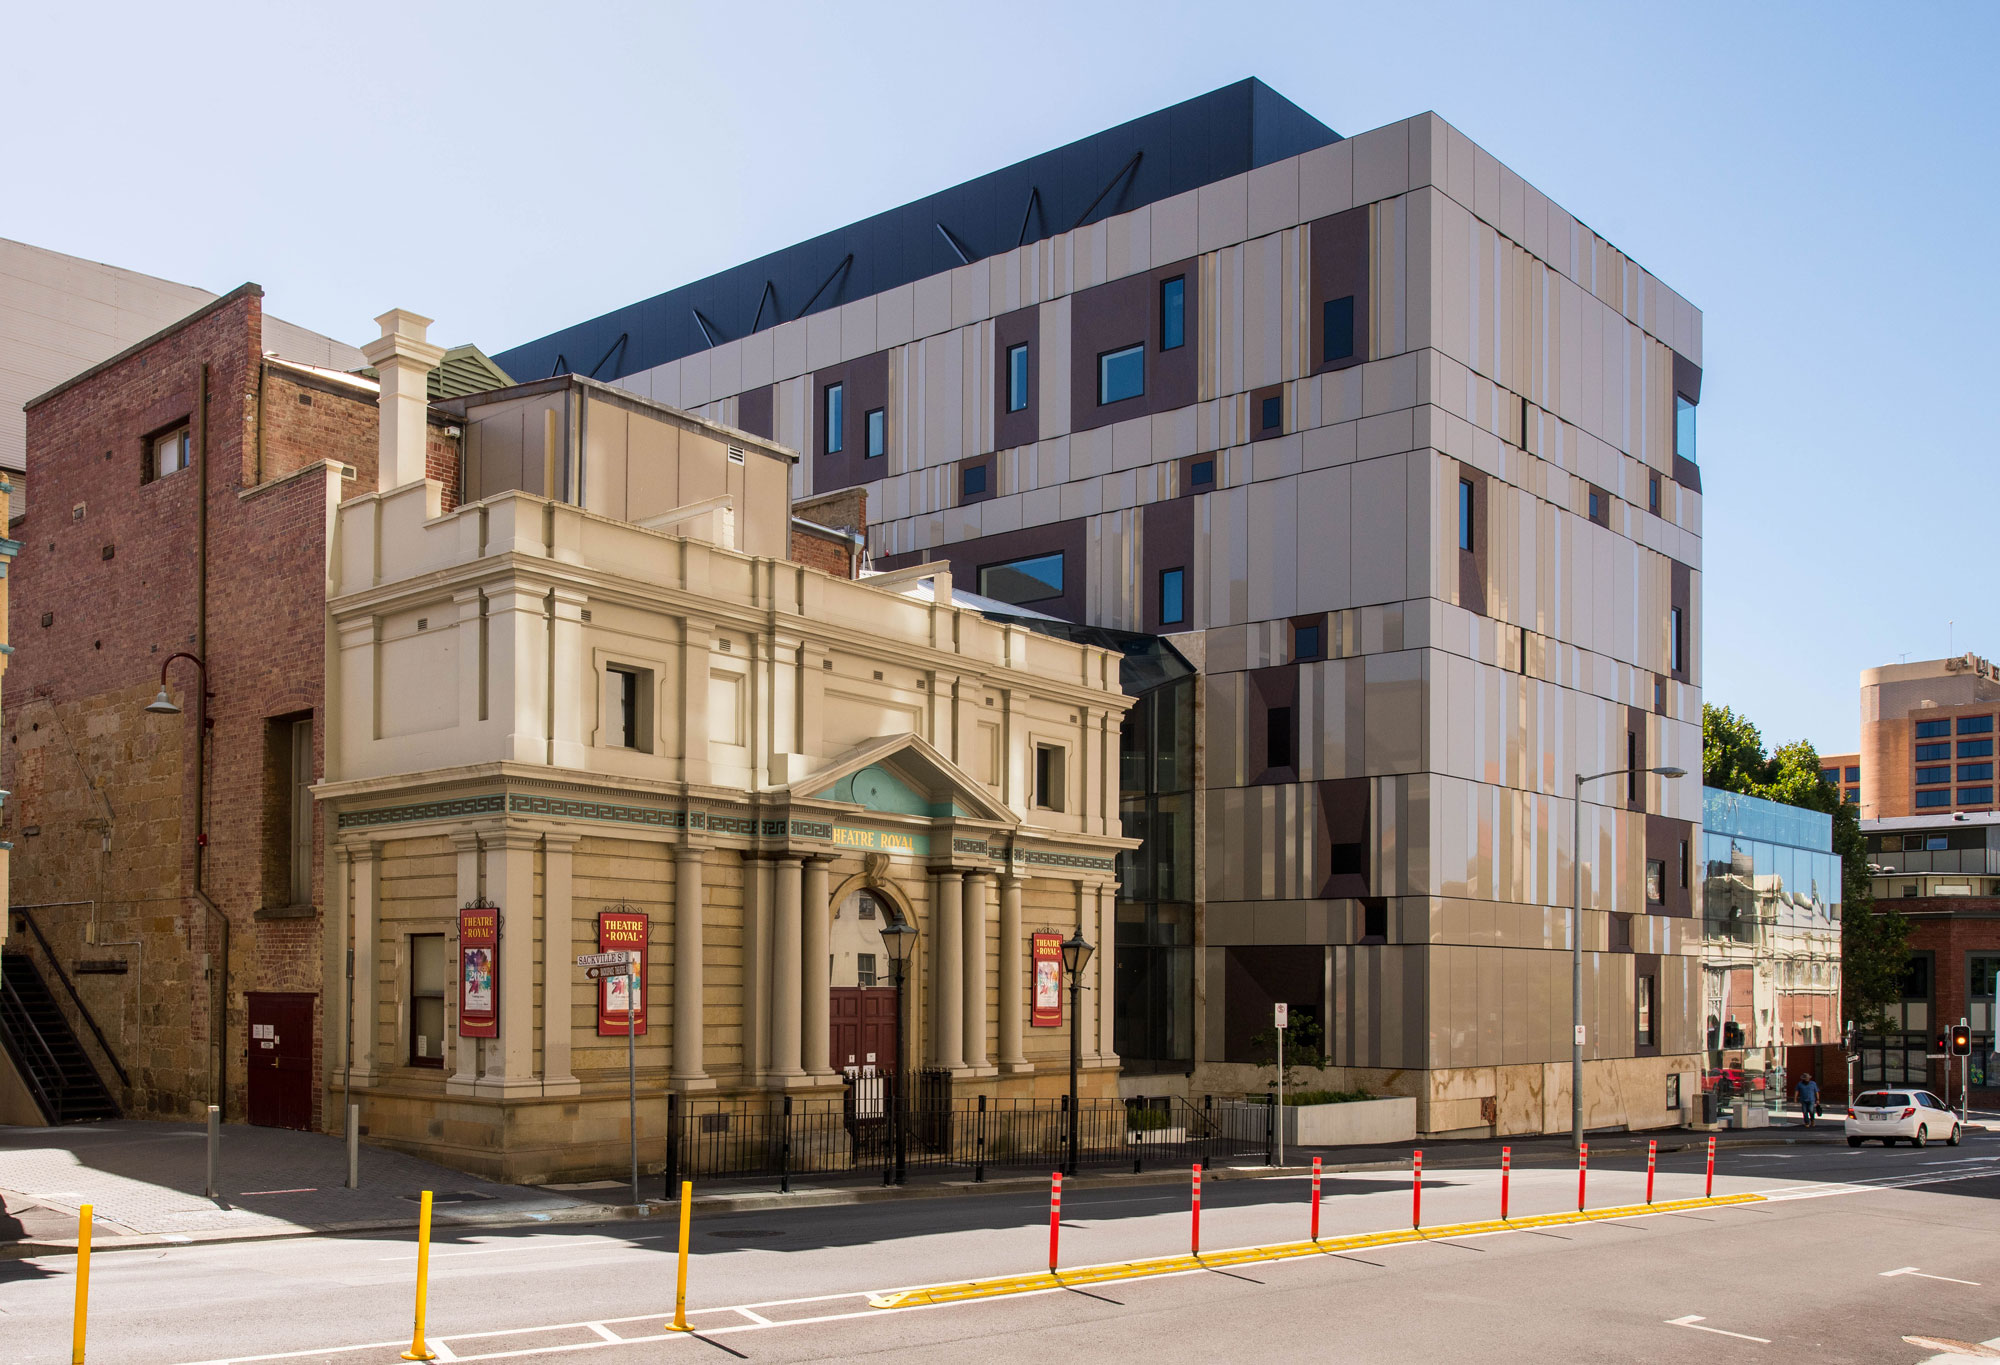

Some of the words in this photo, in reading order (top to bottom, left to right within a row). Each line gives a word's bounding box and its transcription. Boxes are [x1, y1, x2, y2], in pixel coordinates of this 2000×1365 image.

[833, 828, 874, 847] HEATRE
[881, 833, 915, 850] ROYAL
[464, 917, 493, 926] THEATRE
[605, 921, 643, 930] THEATRE
[468, 929, 489, 937] ROYAL
[611, 932, 638, 940] ROYAL
[1036, 940, 1059, 948] THEATRE
[579, 953, 616, 965] SACKVILLE
[469, 971, 487, 981] 2021
